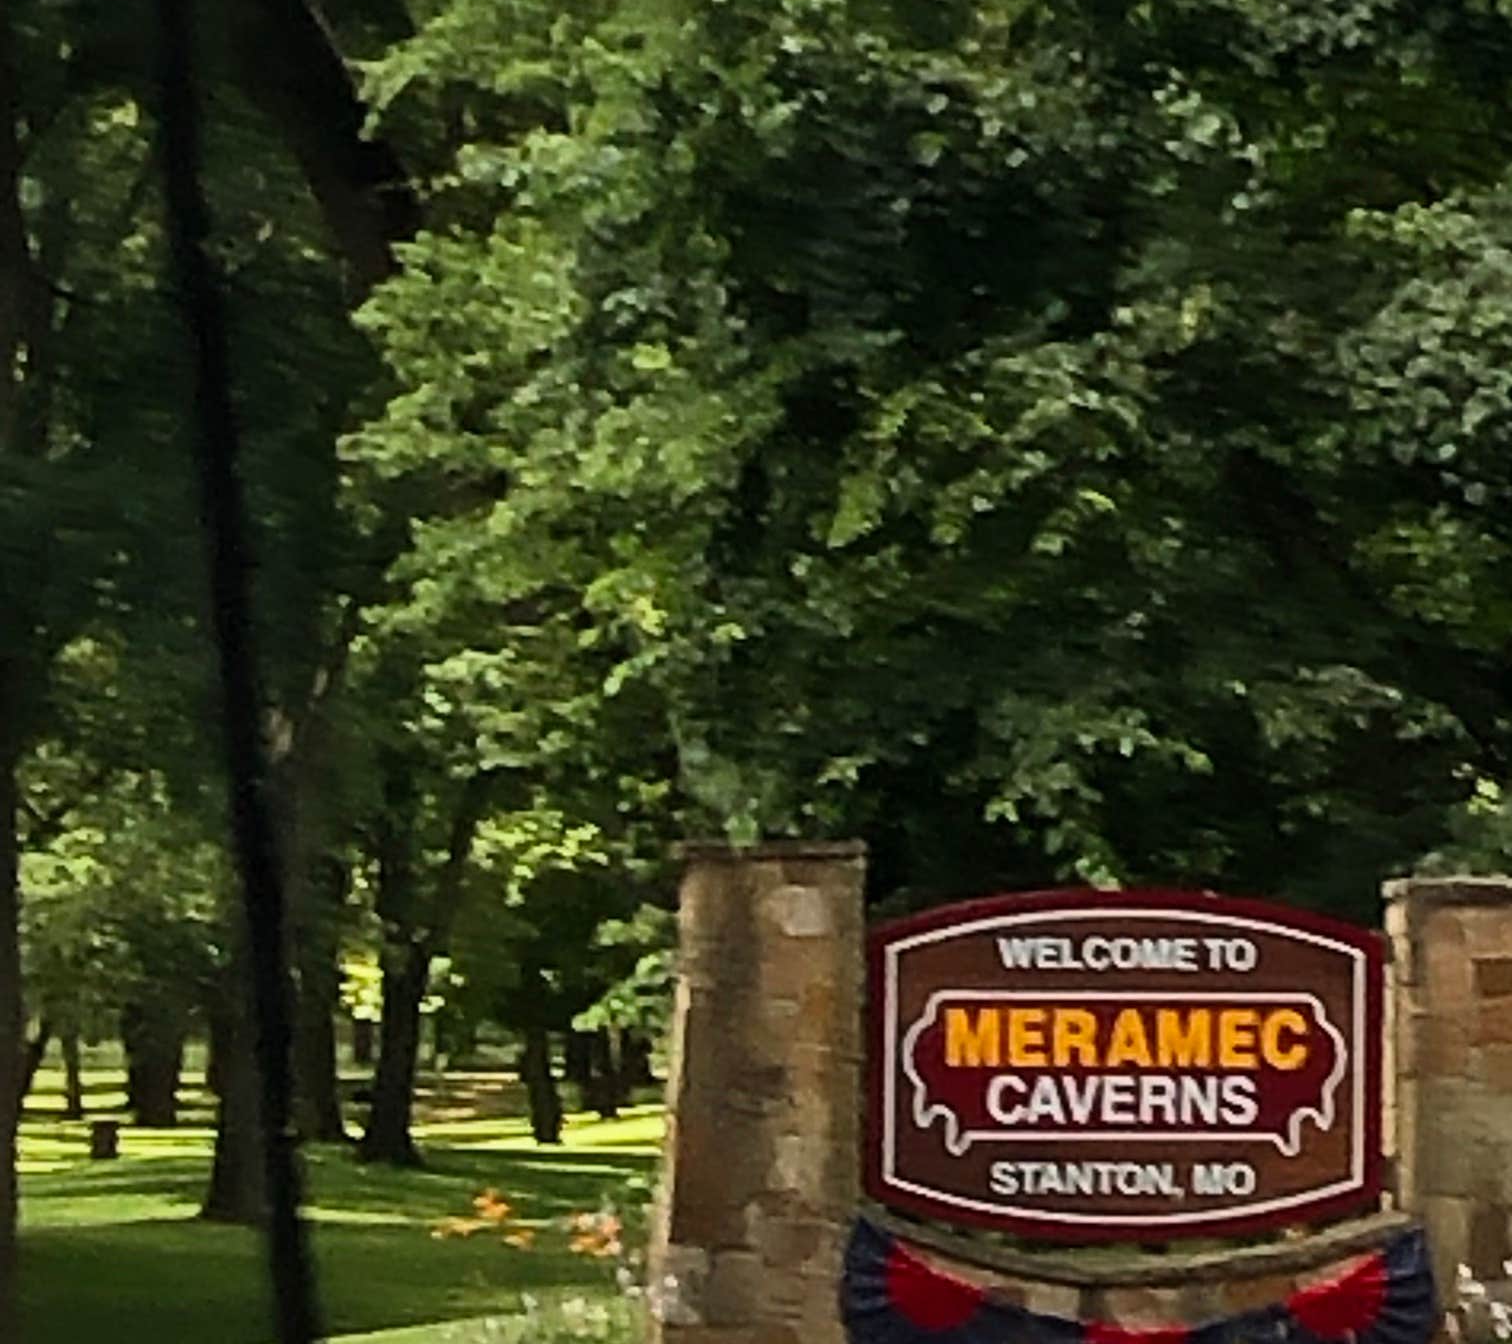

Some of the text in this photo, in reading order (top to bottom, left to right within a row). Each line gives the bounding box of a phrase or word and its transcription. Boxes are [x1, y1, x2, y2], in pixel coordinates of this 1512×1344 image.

[998, 938, 1257, 971] WELCOME TO
[944, 1007, 1308, 1070] MERAMEC
[986, 1075, 1259, 1125] CAVERNS
[990, 1162, 1257, 1198] STANTON, MO
